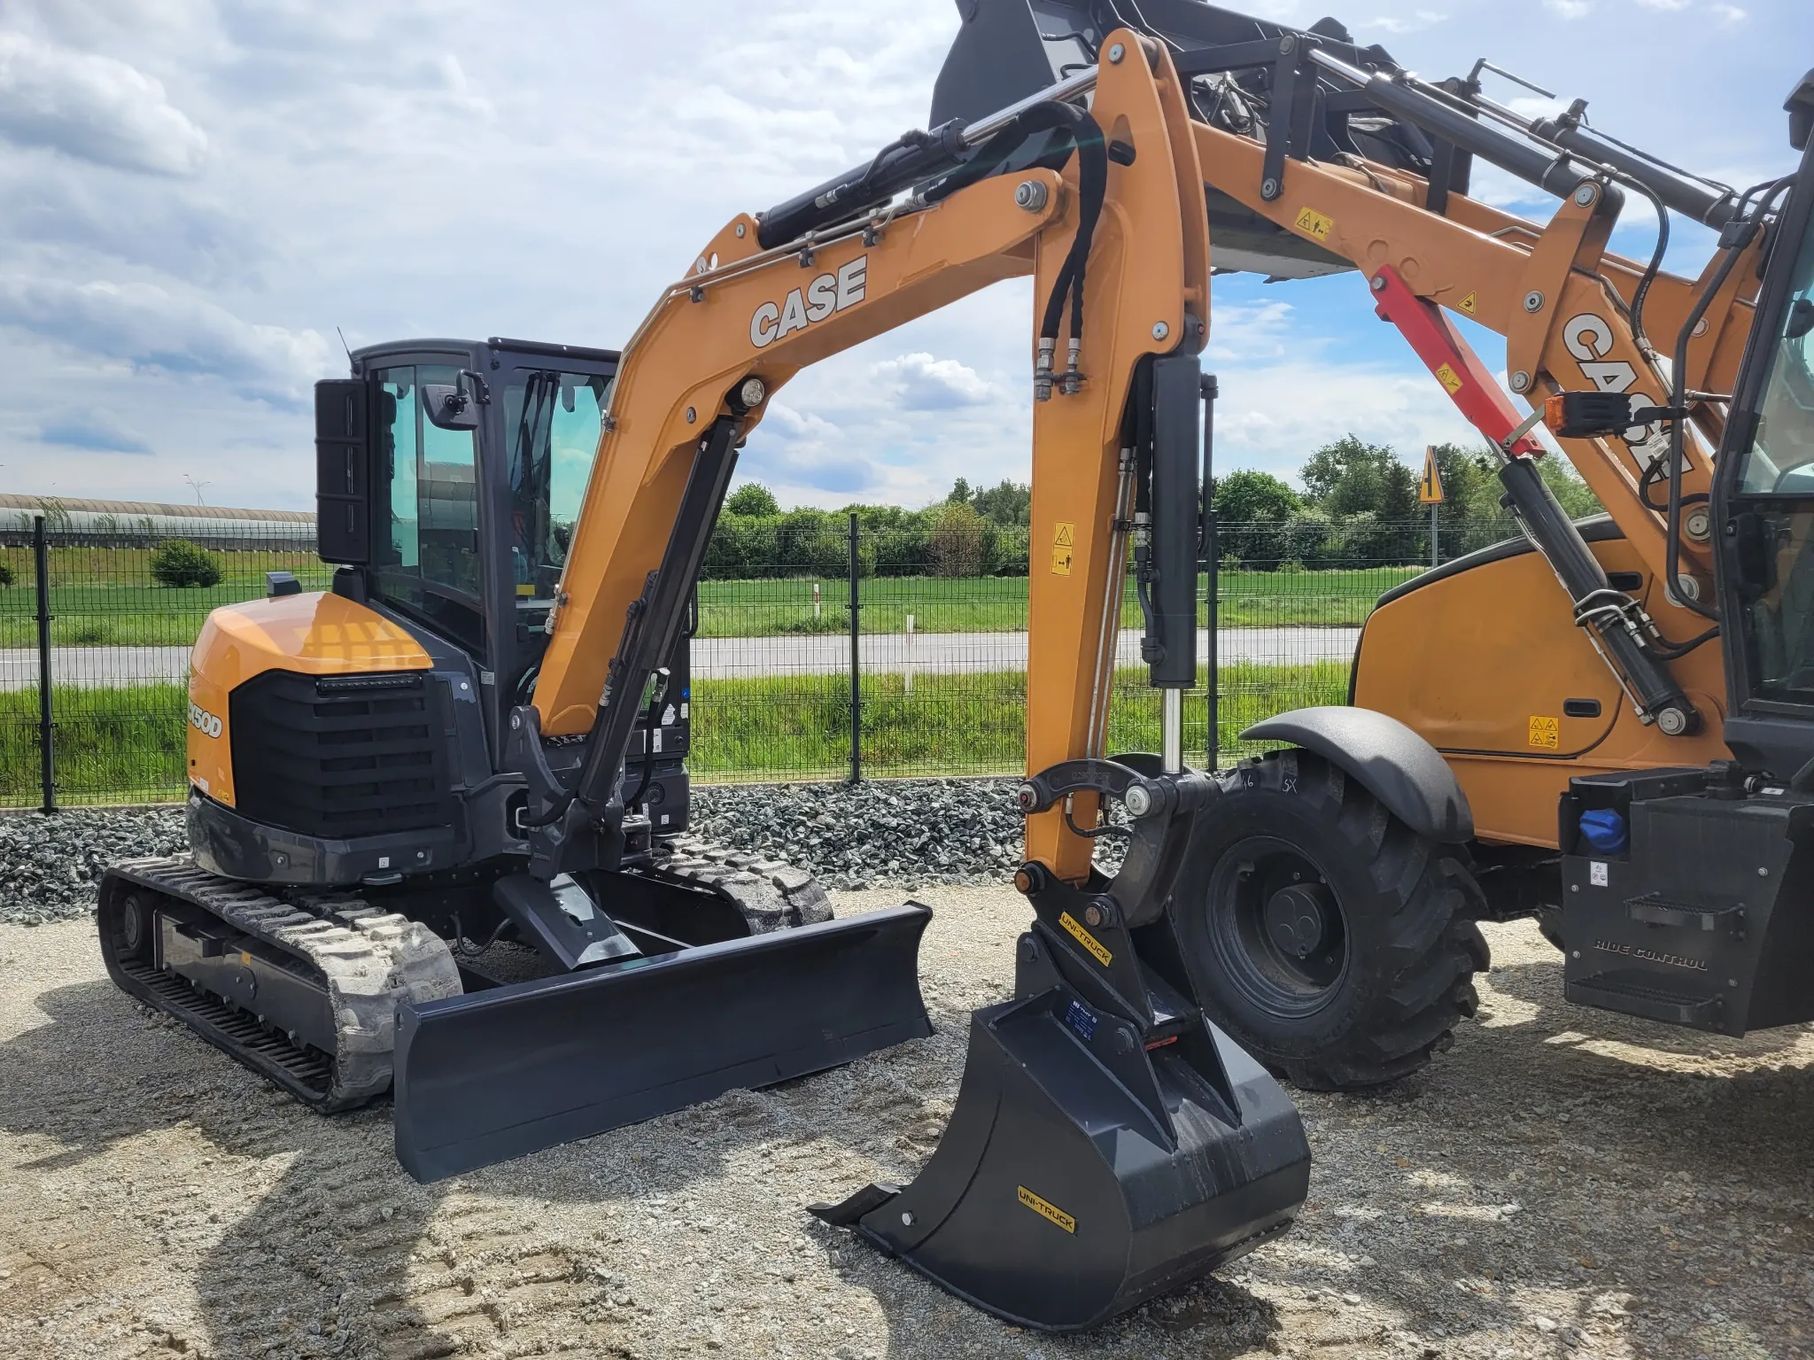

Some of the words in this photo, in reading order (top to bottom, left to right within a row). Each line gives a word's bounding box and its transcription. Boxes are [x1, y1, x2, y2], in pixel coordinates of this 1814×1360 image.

[749, 253, 868, 348] CASE
[1060, 914, 1110, 963] UNI-TRUCK
[1592, 938, 1631, 955] RIDE
[1632, 947, 1708, 972] CONTROL
[1019, 1190, 1074, 1230] UNI-TRUCK
